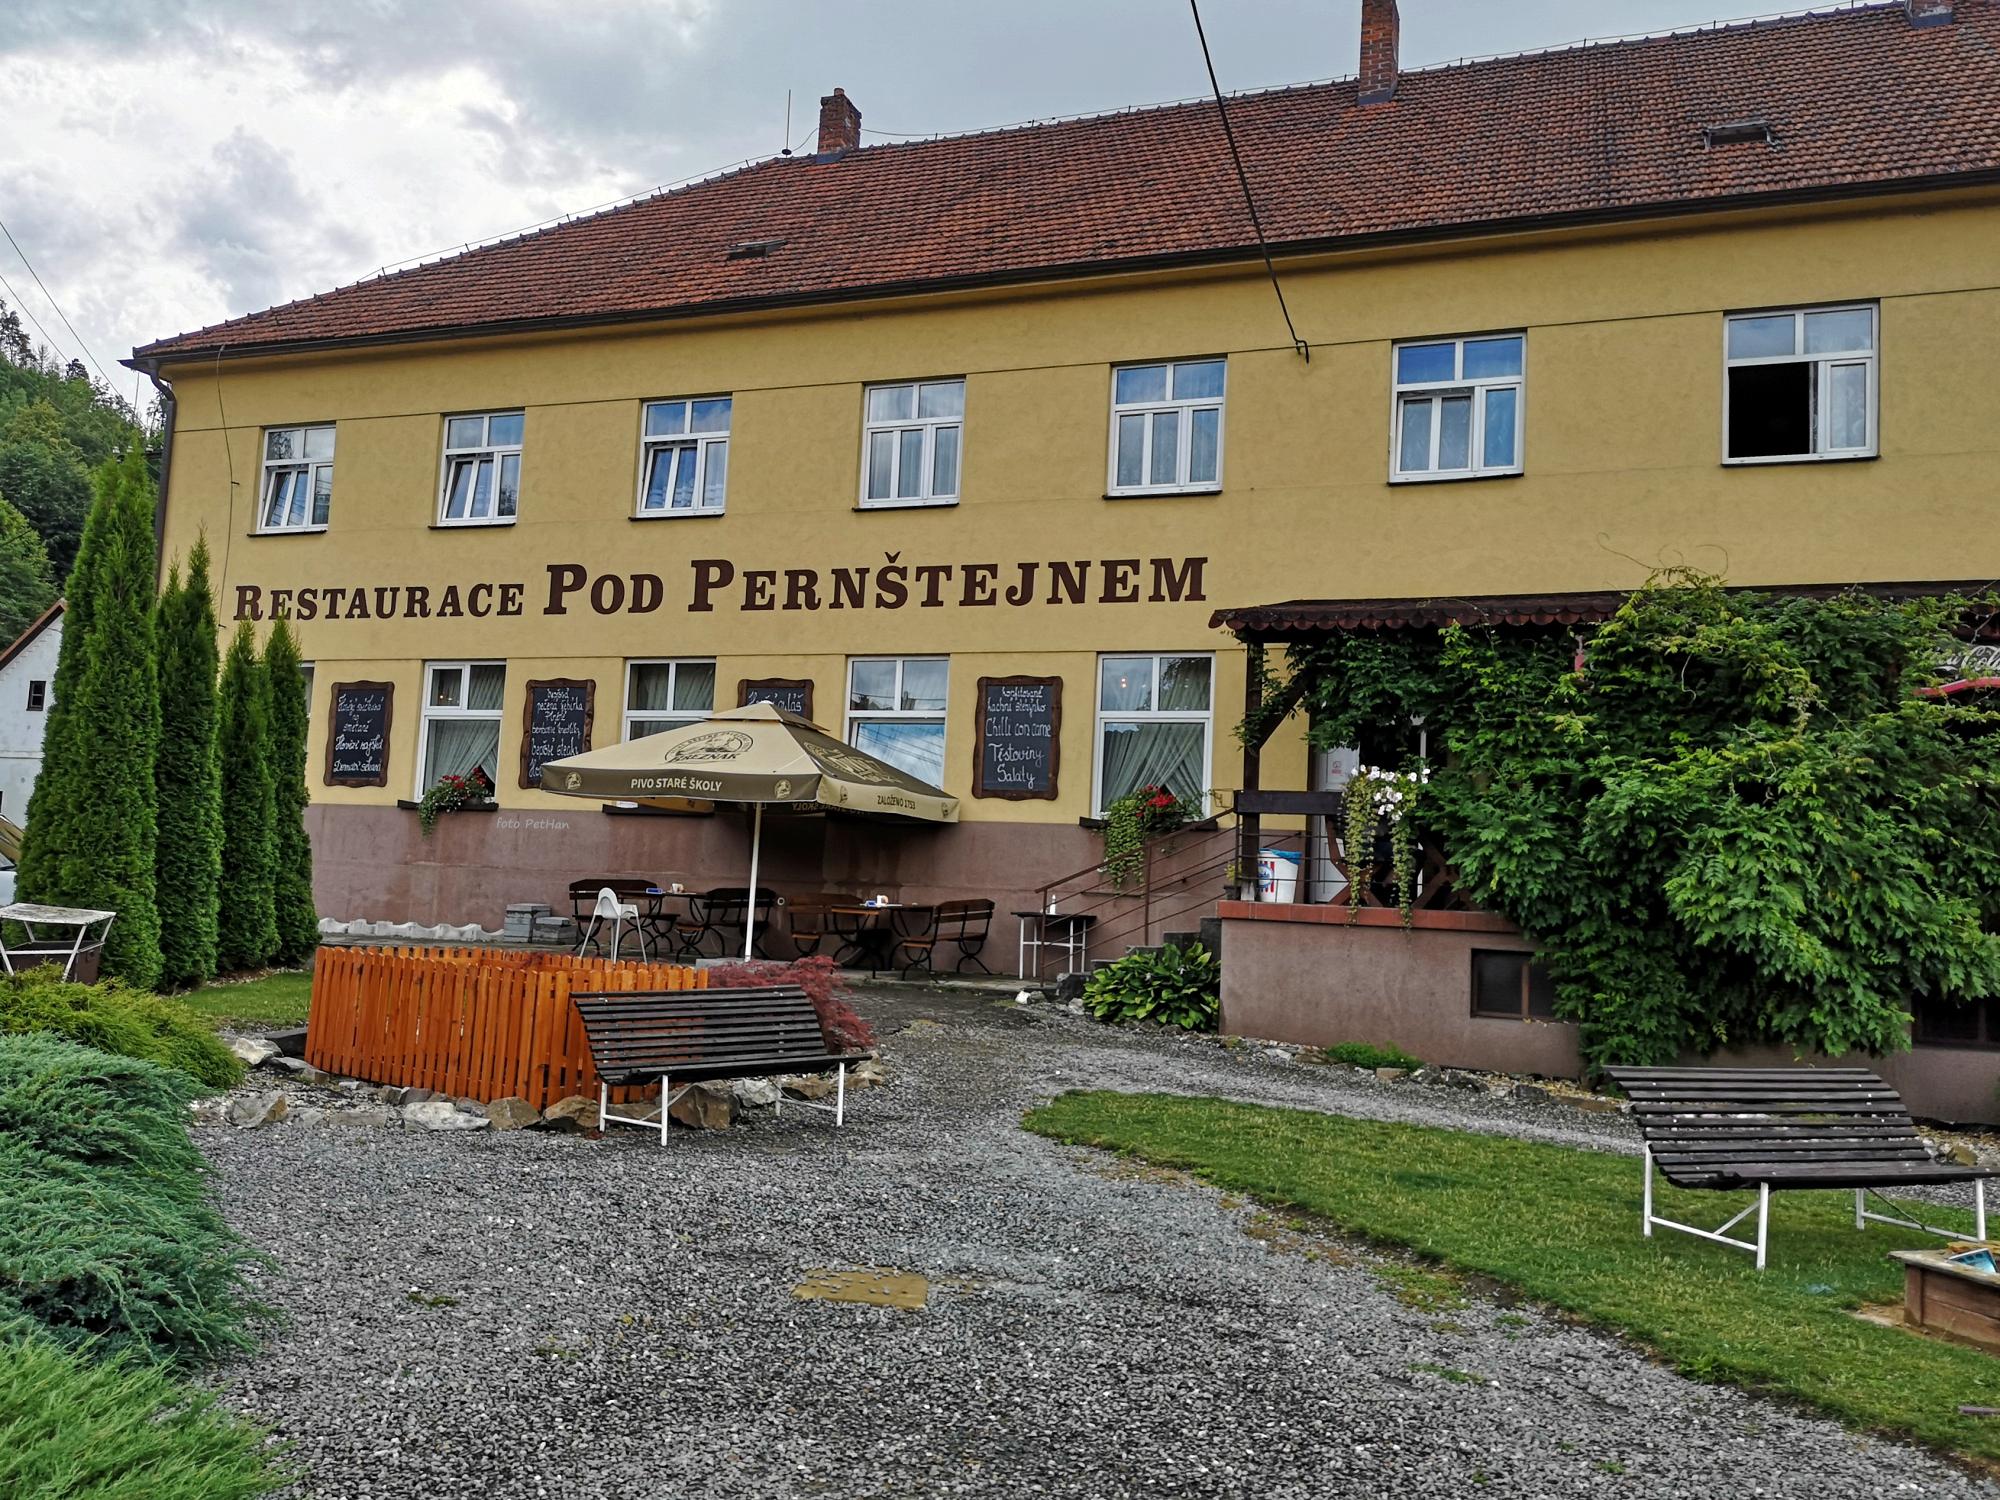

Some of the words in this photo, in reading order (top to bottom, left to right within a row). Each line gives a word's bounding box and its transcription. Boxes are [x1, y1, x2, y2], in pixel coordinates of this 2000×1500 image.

[233, 583, 524, 621] RESTAURACE
[543, 563, 664, 616] POD
[687, 551, 1208, 612] PERNŠTEJNEM
[986, 716, 1011, 737] Chilli
[1014, 723, 1030, 737] con
[631, 778, 655, 789] PIVO
[655, 776, 687, 789] STARÉ
[688, 777, 722, 792] ŠKOLY
